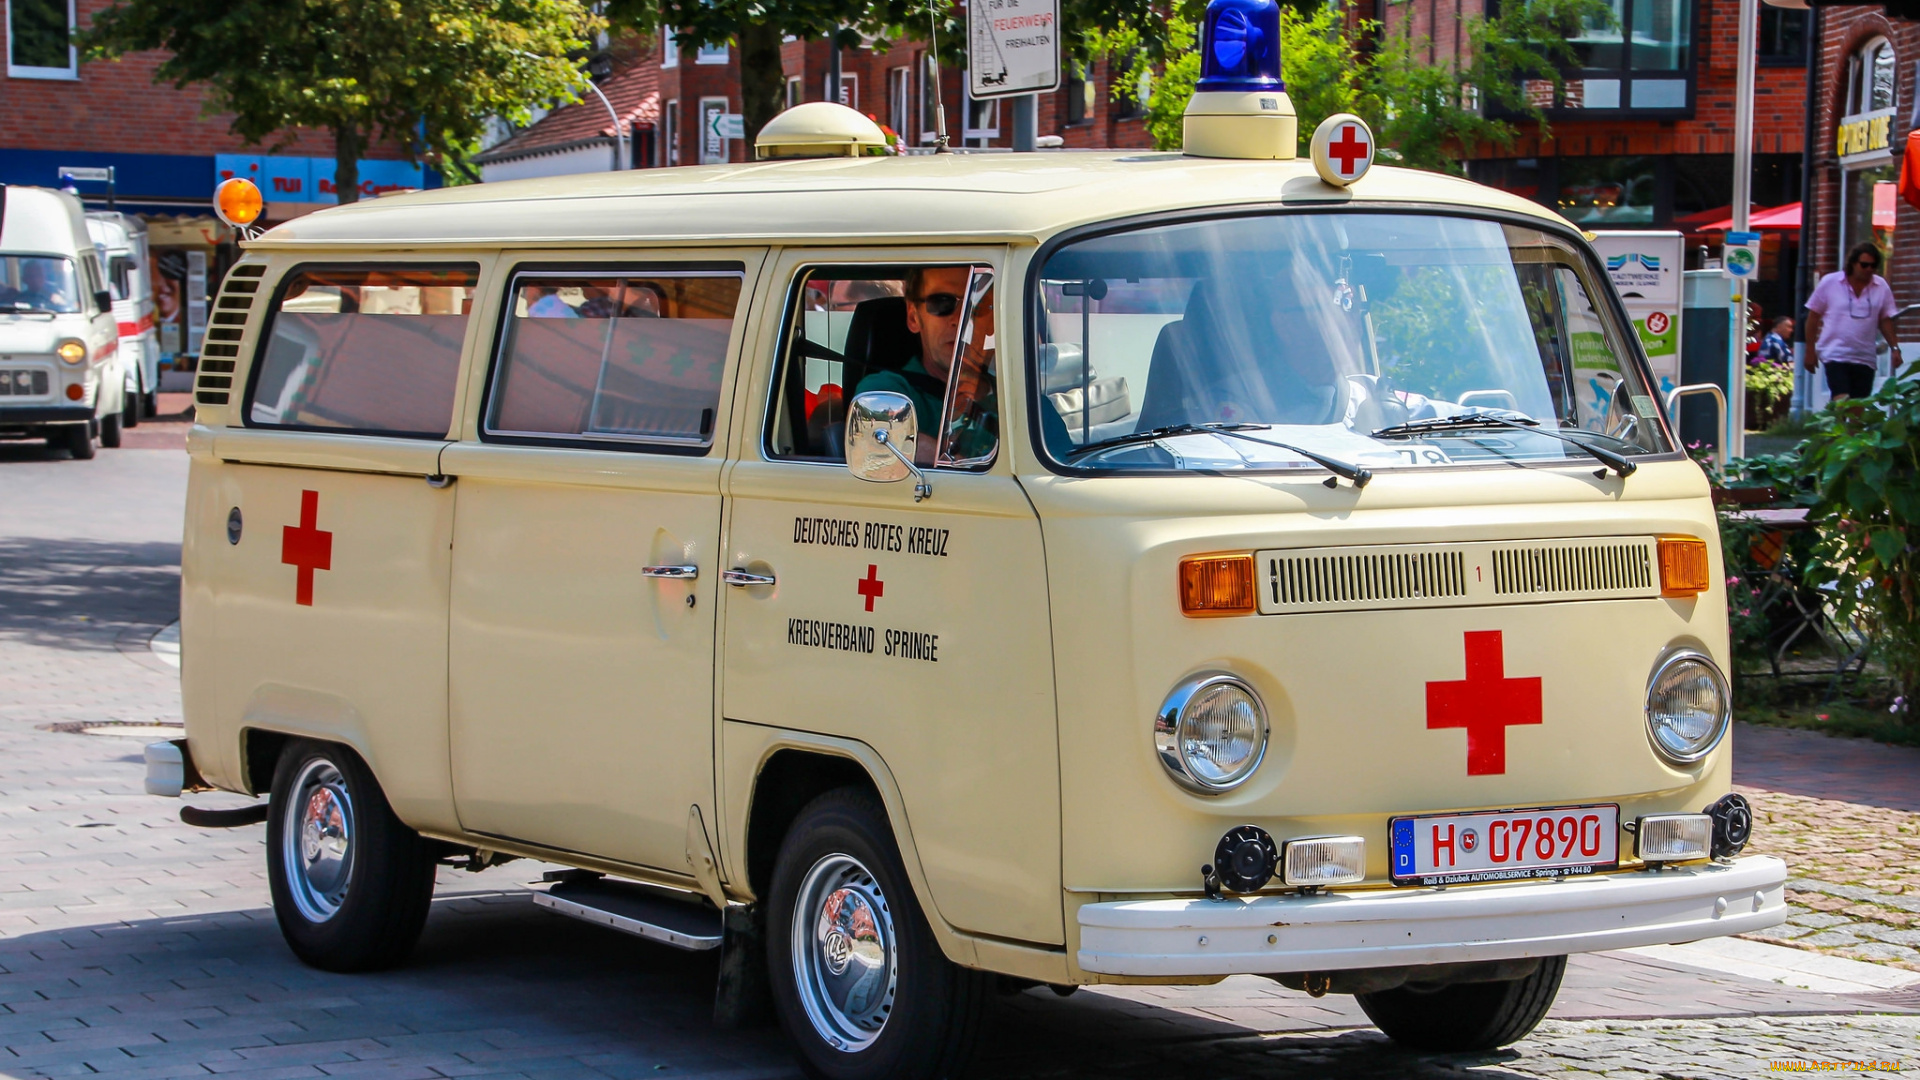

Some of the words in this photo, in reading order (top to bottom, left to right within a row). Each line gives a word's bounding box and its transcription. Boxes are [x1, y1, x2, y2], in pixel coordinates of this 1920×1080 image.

[993, 12, 1053, 31] FEUERWEHR
[1005, 35, 1050, 49] FREIHALTEN
[273, 177, 302, 192] TUI
[793, 517, 860, 548] DEUTSCHES
[864, 522, 903, 552] ROTES
[907, 526, 950, 557] KREUZ
[1476, 565, 1482, 583] 1
[787, 618, 875, 654] KREISVERBAND
[884, 628, 939, 663] SPRINGE
[1432, 823, 1455, 867] H
[1489, 815, 1600, 863] 07890
[1400, 854, 1409, 867] D
[1438, 875, 1445, 884] &
[1471, 869, 1531, 882] AUTOMOBILSERVICE
[1535, 868, 1559, 877] Springe
